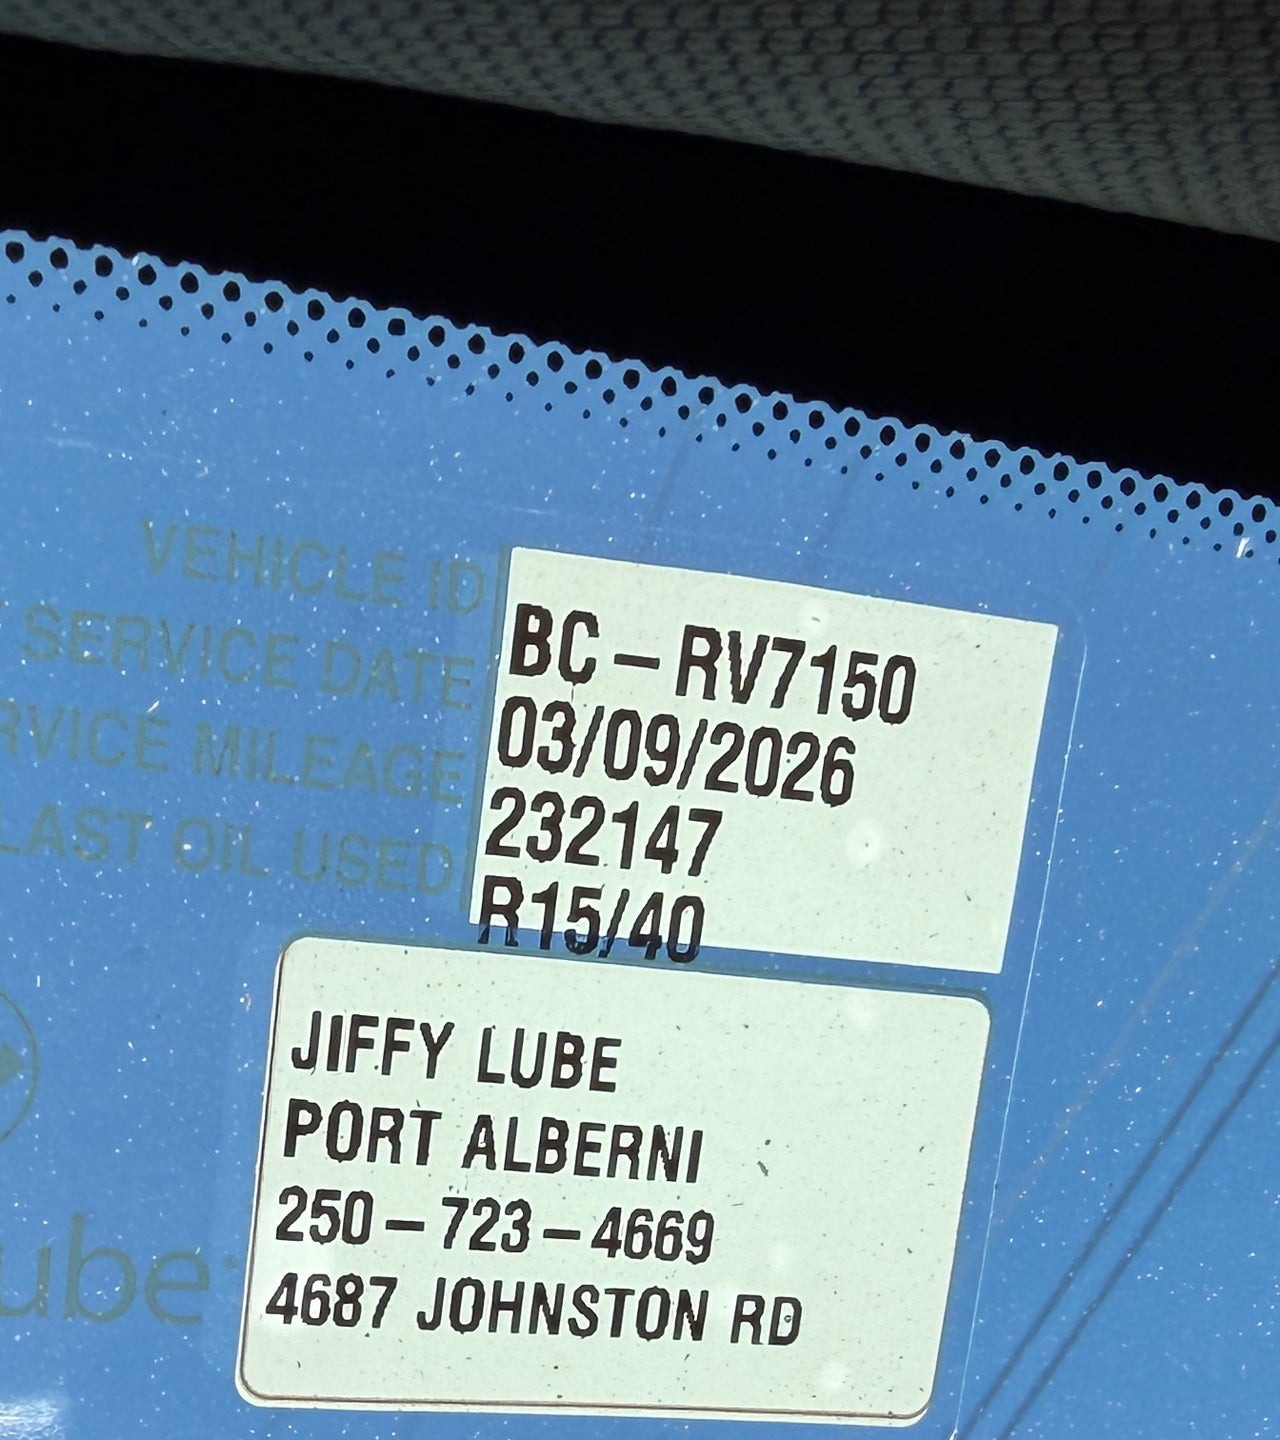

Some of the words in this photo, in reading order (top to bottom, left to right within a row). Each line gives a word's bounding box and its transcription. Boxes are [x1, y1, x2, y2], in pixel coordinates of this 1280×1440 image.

[140, 519, 408, 605] VEHICLE
[429, 557, 485, 616] ID
[22, 605, 299, 690] SERVICE
[320, 638, 477, 711] DATE
[193, 721, 466, 803] MILEAGE
[497, 695, 857, 807] 03/09/2026
[172, 815, 268, 877] OIL
[292, 830, 455, 894] USED
[485, 787, 723, 877] 232147
[478, 876, 705, 963] R15/40
[291, 1011, 455, 1079] JIFFY
[478, 1026, 622, 1092] LUBE
[284, 1099, 442, 1165] PORT
[462, 1114, 704, 1182] ALBERNI
[266, 1272, 398, 1329] 4687
[418, 1276, 708, 1341] JOHNSTON
[731, 1296, 802, 1345] RD
